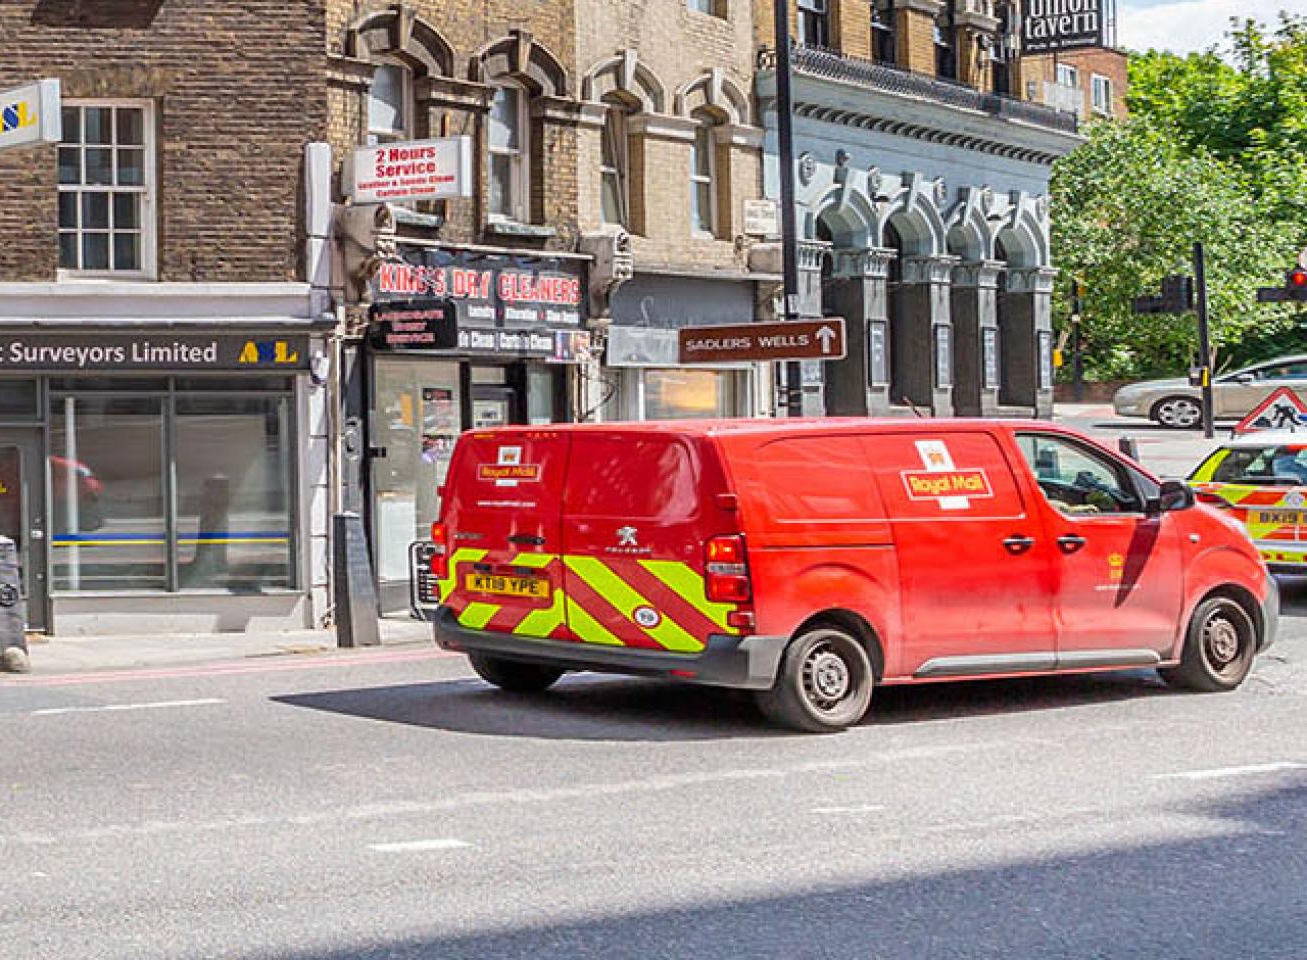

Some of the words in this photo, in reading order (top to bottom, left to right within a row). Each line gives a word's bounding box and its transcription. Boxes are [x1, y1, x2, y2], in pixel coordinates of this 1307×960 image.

[1025, 11, 1098, 40] tavern
[375, 148, 386, 164] 2
[389, 146, 437, 162] Hours
[375, 162, 436, 179] Service
[452, 268, 491, 299] DRY
[497, 272, 581, 304] CLEANERS
[686, 336, 752, 352] SADLERS
[757, 334, 810, 348] WELLS
[9, 341, 126, 367] Surveyors
[132, 341, 218, 363] Limited
[481, 465, 512, 478] Royal
[513, 466, 536, 478] Mail
[909, 474, 951, 495] Royal
[951, 473, 984, 491] Mail
[509, 578, 540, 594] YPE
